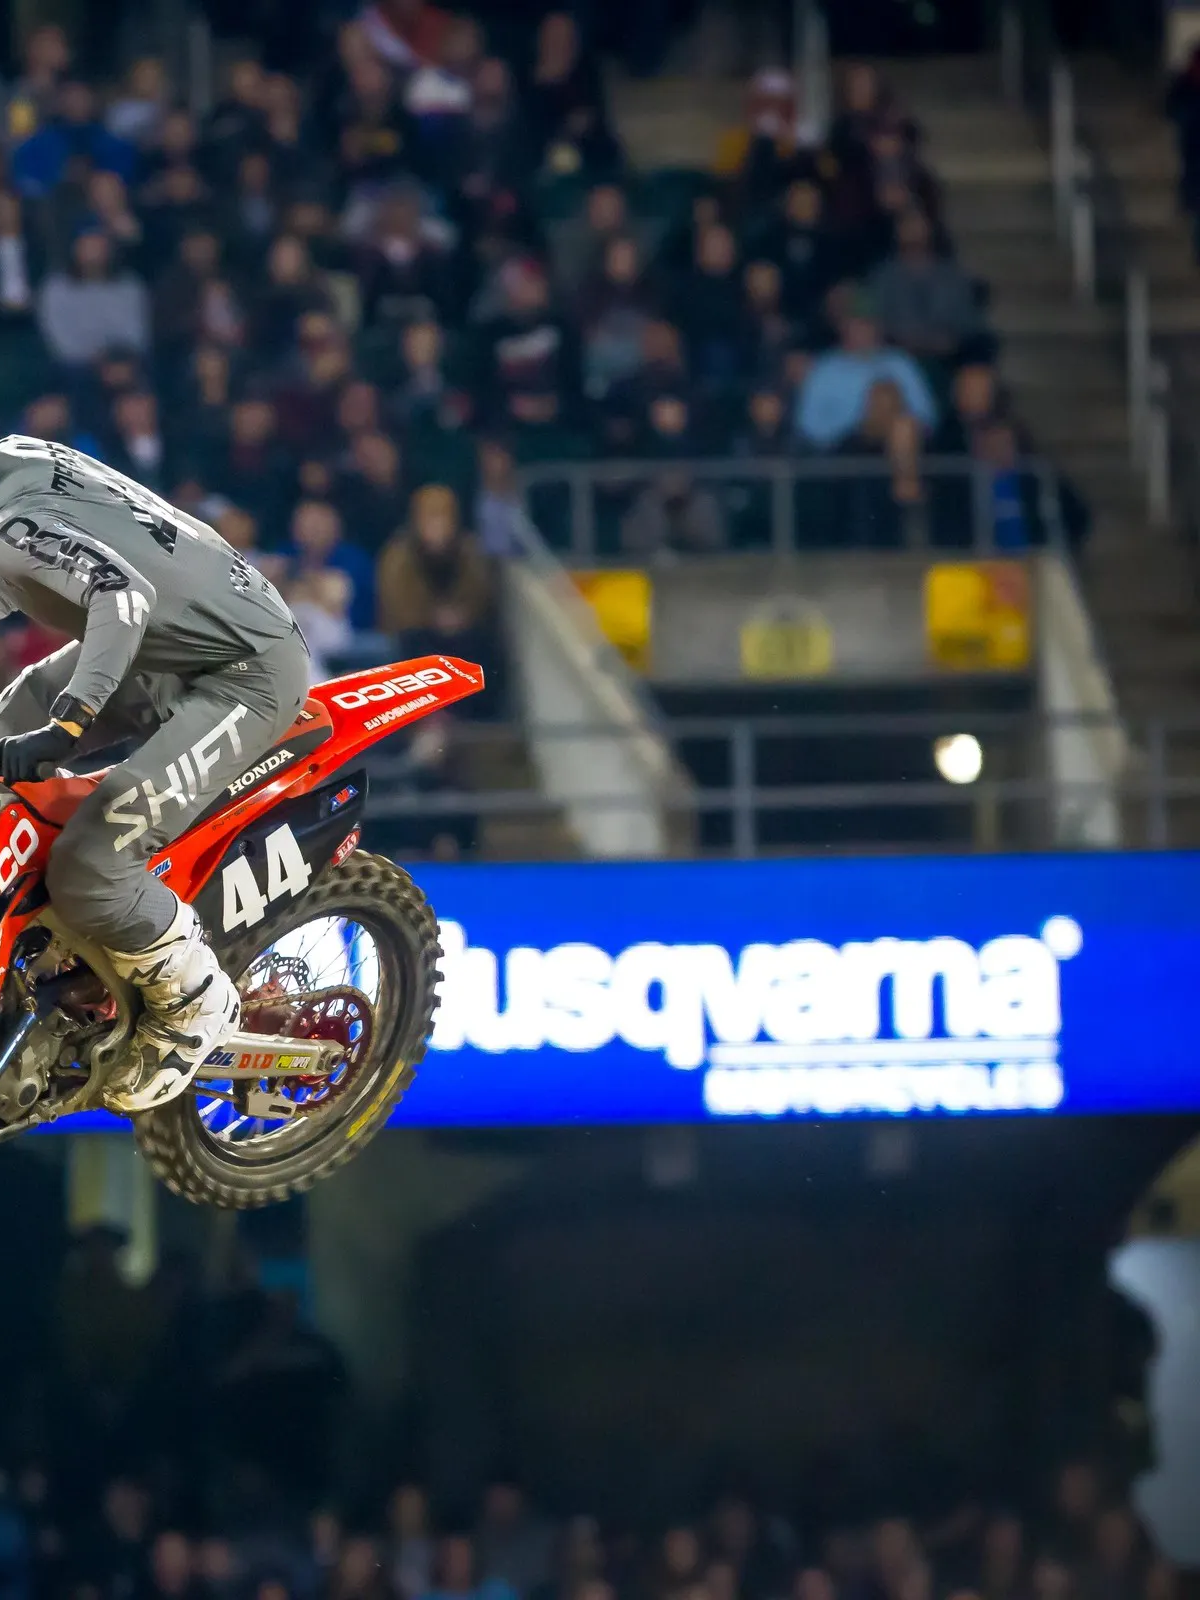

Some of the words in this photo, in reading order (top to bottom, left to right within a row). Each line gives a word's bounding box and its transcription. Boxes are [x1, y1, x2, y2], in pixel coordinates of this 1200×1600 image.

[331, 667, 452, 710] GEICO
[104, 703, 248, 853] SHIFT
[226, 749, 295, 797] HONDA
[222, 822, 312, 933] 44
